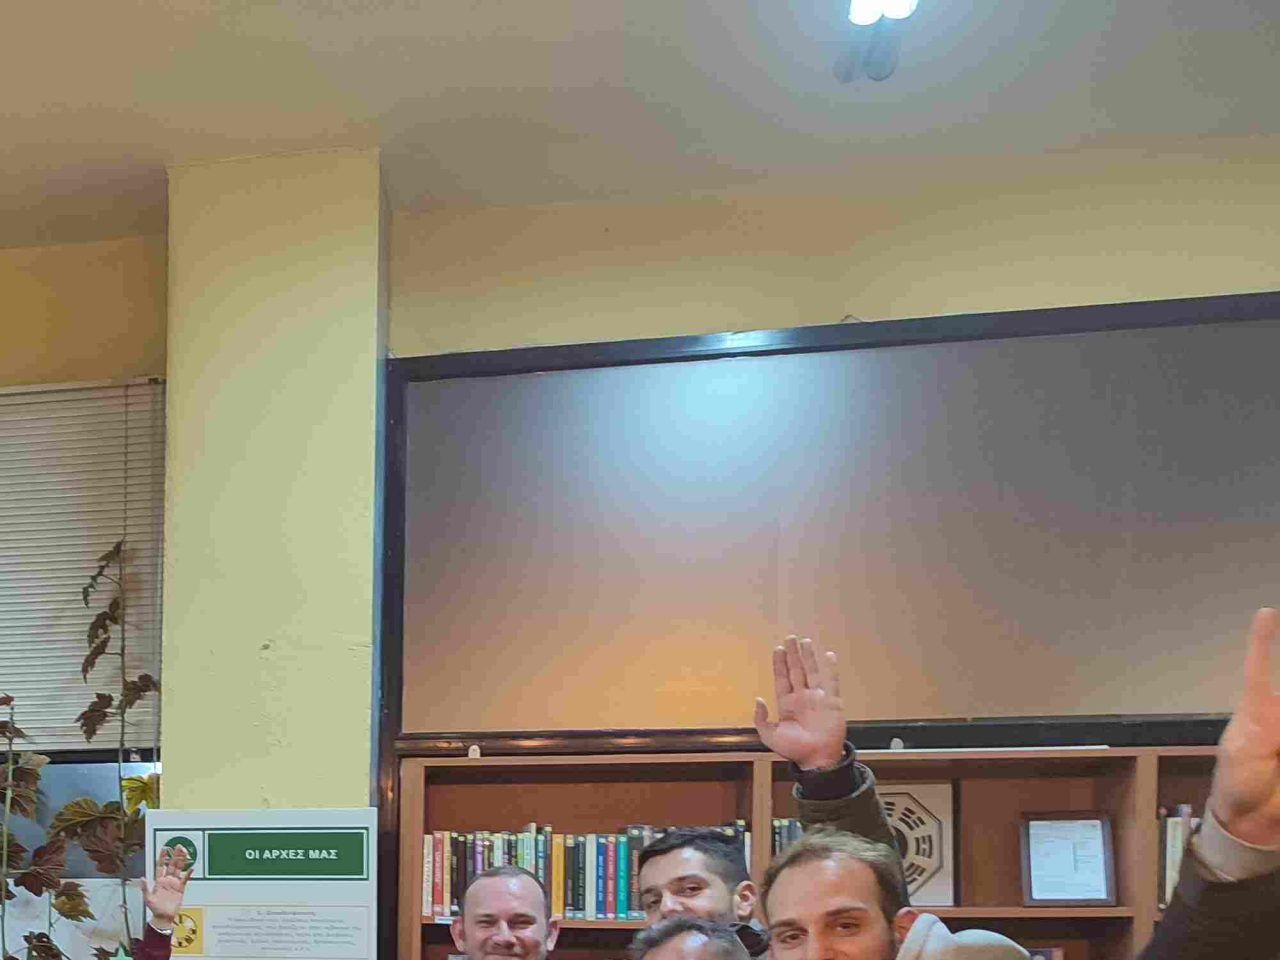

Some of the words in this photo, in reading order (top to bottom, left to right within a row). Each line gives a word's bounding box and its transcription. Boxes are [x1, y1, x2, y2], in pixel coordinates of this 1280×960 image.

[245, 849, 260, 860] ΟΙ
[262, 849, 306, 860] ΑΡΧΕΣ
[308, 849, 339, 860] ΜΑΣ
